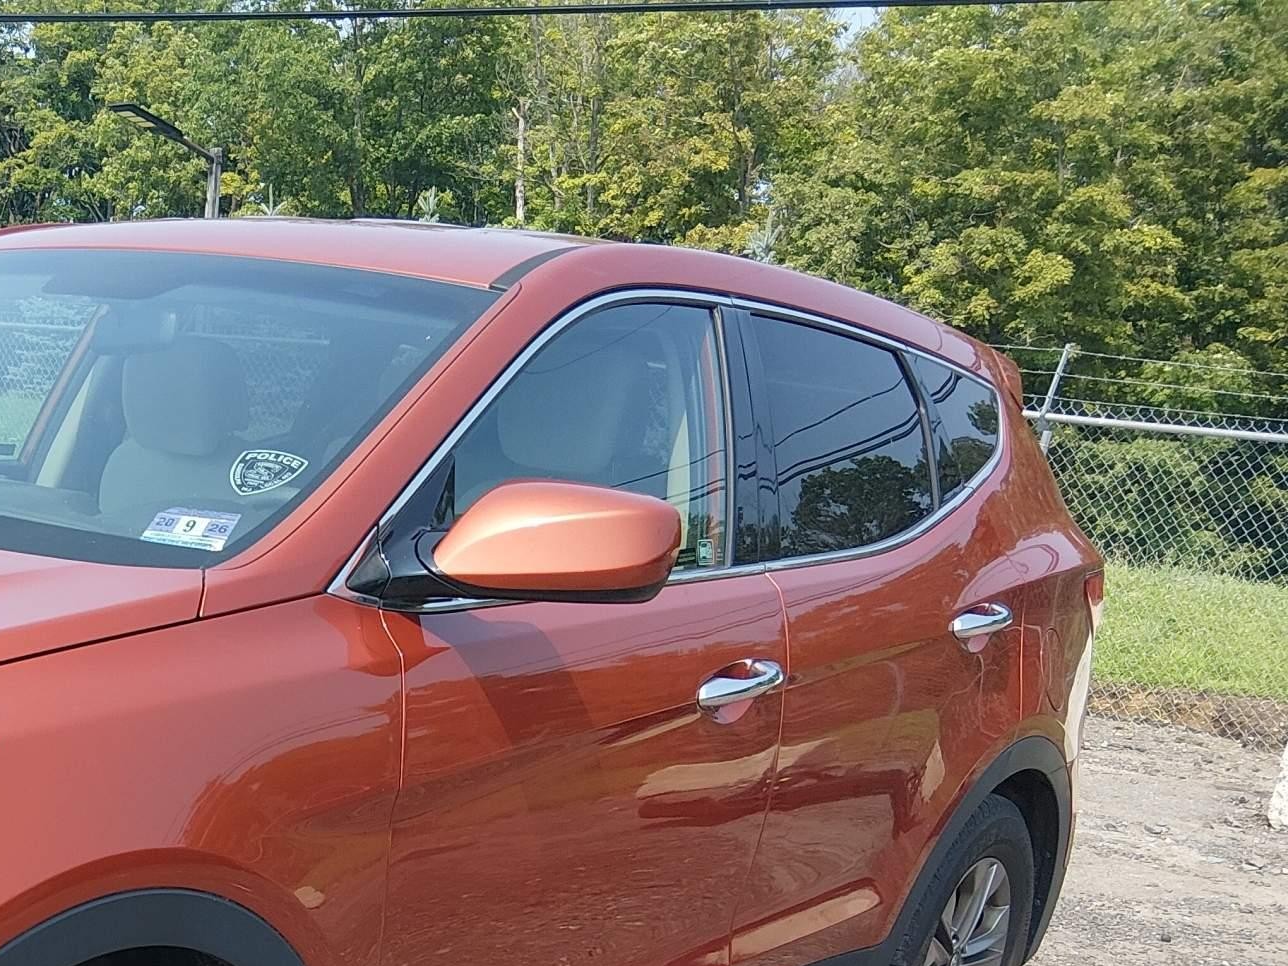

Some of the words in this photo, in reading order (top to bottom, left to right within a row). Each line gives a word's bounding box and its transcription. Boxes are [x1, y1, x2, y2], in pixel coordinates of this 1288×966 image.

[245, 453, 302, 469] POLICE
[155, 517, 174, 528] 20
[183, 519, 197, 532] 9
[208, 523, 229, 534] 26
